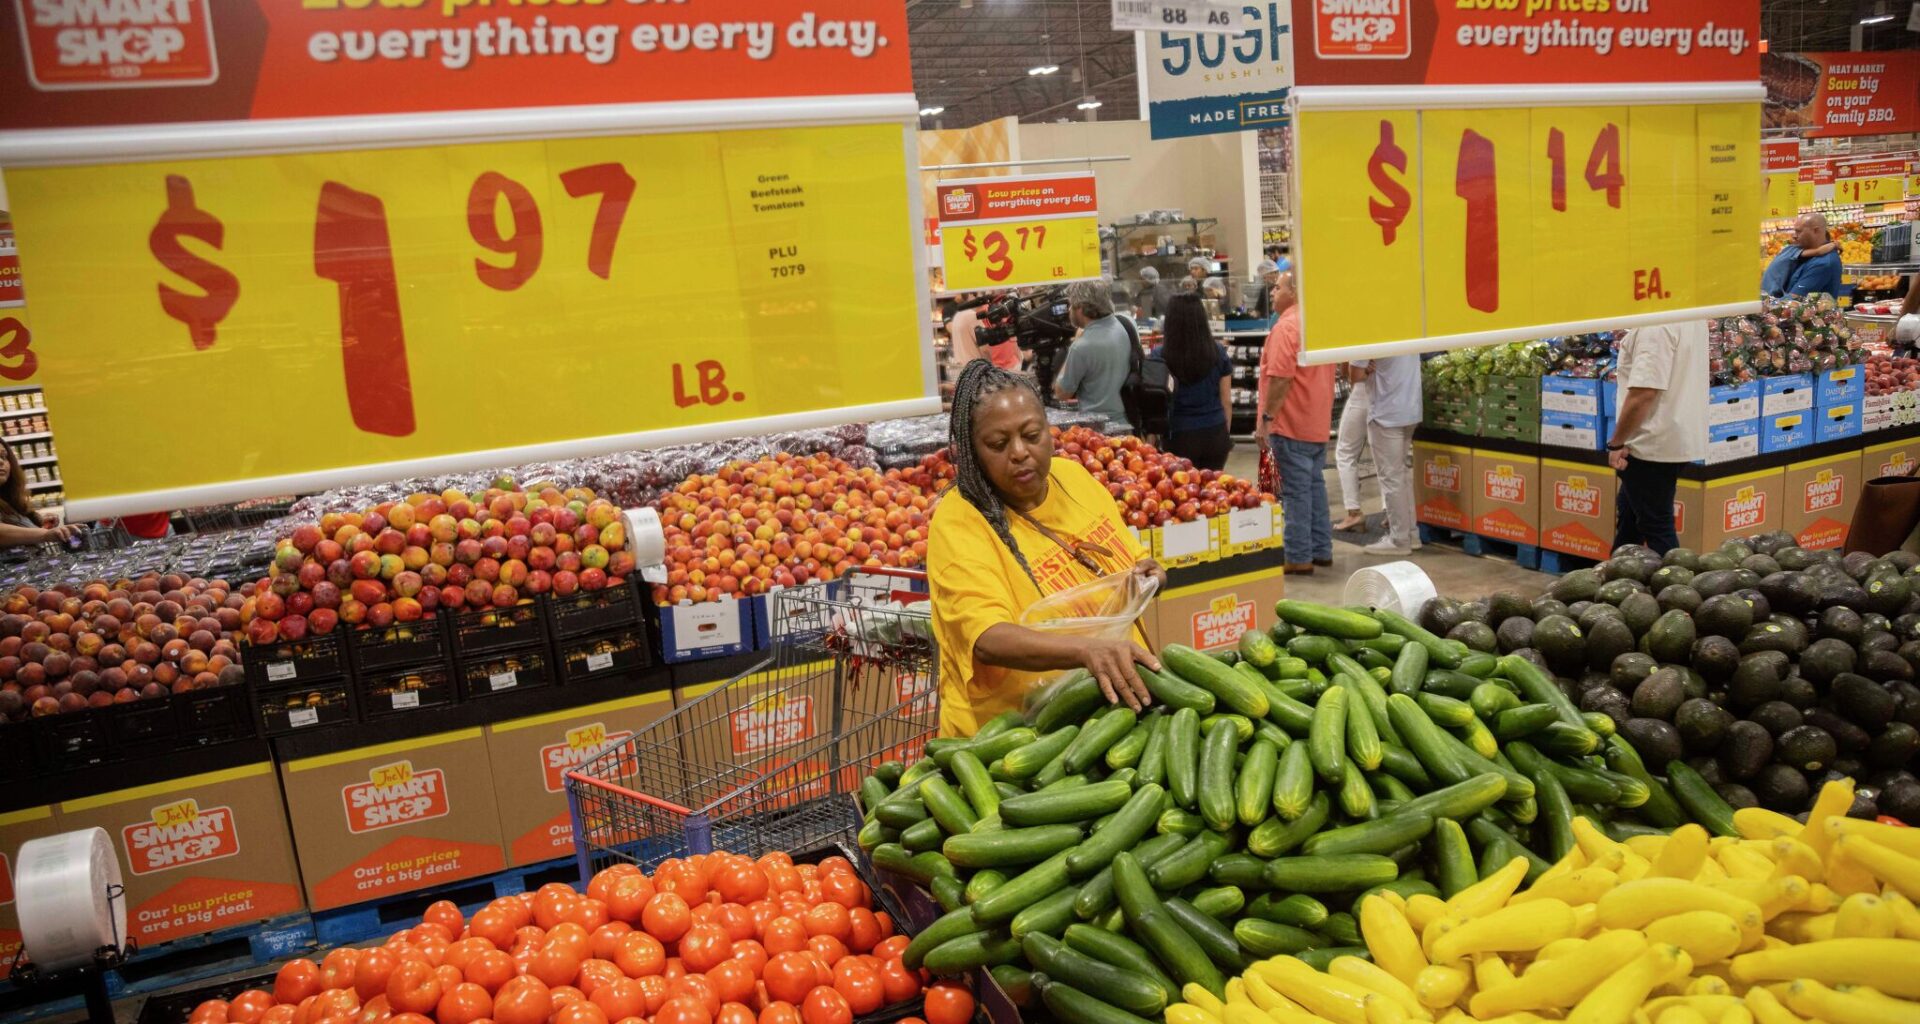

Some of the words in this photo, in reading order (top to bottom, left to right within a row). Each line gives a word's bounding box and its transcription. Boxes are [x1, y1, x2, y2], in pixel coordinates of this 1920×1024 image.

[1162, 8, 1187, 24] 88
[1208, 11, 1230, 25] A6
[1331, 17, 1396, 42] SHOP
[1456, 19, 1613, 54] everything
[1619, 24, 1692, 55] every
[1697, 22, 1748, 55] day.
[56, 27, 185, 65] SHOP
[308, 15, 619, 69] everything
[631, 21, 775, 60] every
[787, 12, 888, 58] day.
[1204, 69, 1262, 81] SUSHI
[1828, 64, 1851, 74] MEAT
[1853, 63, 1885, 73] MARKET
[1827, 77, 1858, 90] Save
[1859, 76, 1879, 92] big
[1827, 95, 1842, 106] on
[1844, 94, 1872, 109] your
[1190, 109, 1236, 124] MADE
[1826, 110, 1865, 126] family
[1867, 109, 1896, 122] BBQ.
[757, 173, 789, 184] Green
[750, 185, 804, 199] Beefsteak
[988, 190, 1009, 198] Low
[1010, 188, 1041, 199] prices
[1042, 187, 1054, 195] on
[753, 200, 805, 212] Tomatoes
[988, 196, 1042, 209] everything
[1043, 195, 1071, 206] every
[1072, 193, 1093, 205] day.
[769, 246, 797, 259] PLU
[770, 264, 805, 278] 7079
[1052, 266, 1067, 277] LB.
[1633, 268, 1671, 301] EA.
[672, 360, 745, 409] LB.
[1488, 473, 1523, 489] SMART
[1807, 479, 1840, 497] SMART
[1491, 486, 1519, 500] SHOP
[1558, 484, 1597, 502] SMART
[1810, 493, 1836, 509] SHOP
[1562, 498, 1593, 513] SHOP
[1727, 496, 1762, 515] SMART
[1730, 510, 1758, 527] SHOP
[1197, 604, 1252, 631] SMART
[1203, 623, 1247, 646] SHOP
[351, 774, 437, 808] SMART
[364, 796, 432, 826] SHOP
[131, 812, 225, 849] SMART
[147, 835, 221, 867] SHOP
[354, 865, 383, 879] Our
[386, 860, 413, 872] low
[416, 849, 461, 869] prices
[357, 877, 383, 890] are
[386, 874, 396, 884] a
[399, 868, 422, 880] big
[425, 860, 461, 875] deal.
[138, 908, 170, 922] Our
[172, 902, 202, 914] low
[205, 889, 254, 910] prices
[142, 919, 170, 934] are
[172, 916, 184, 927] a
[187, 909, 213, 924] big
[216, 900, 254, 918] deal.
